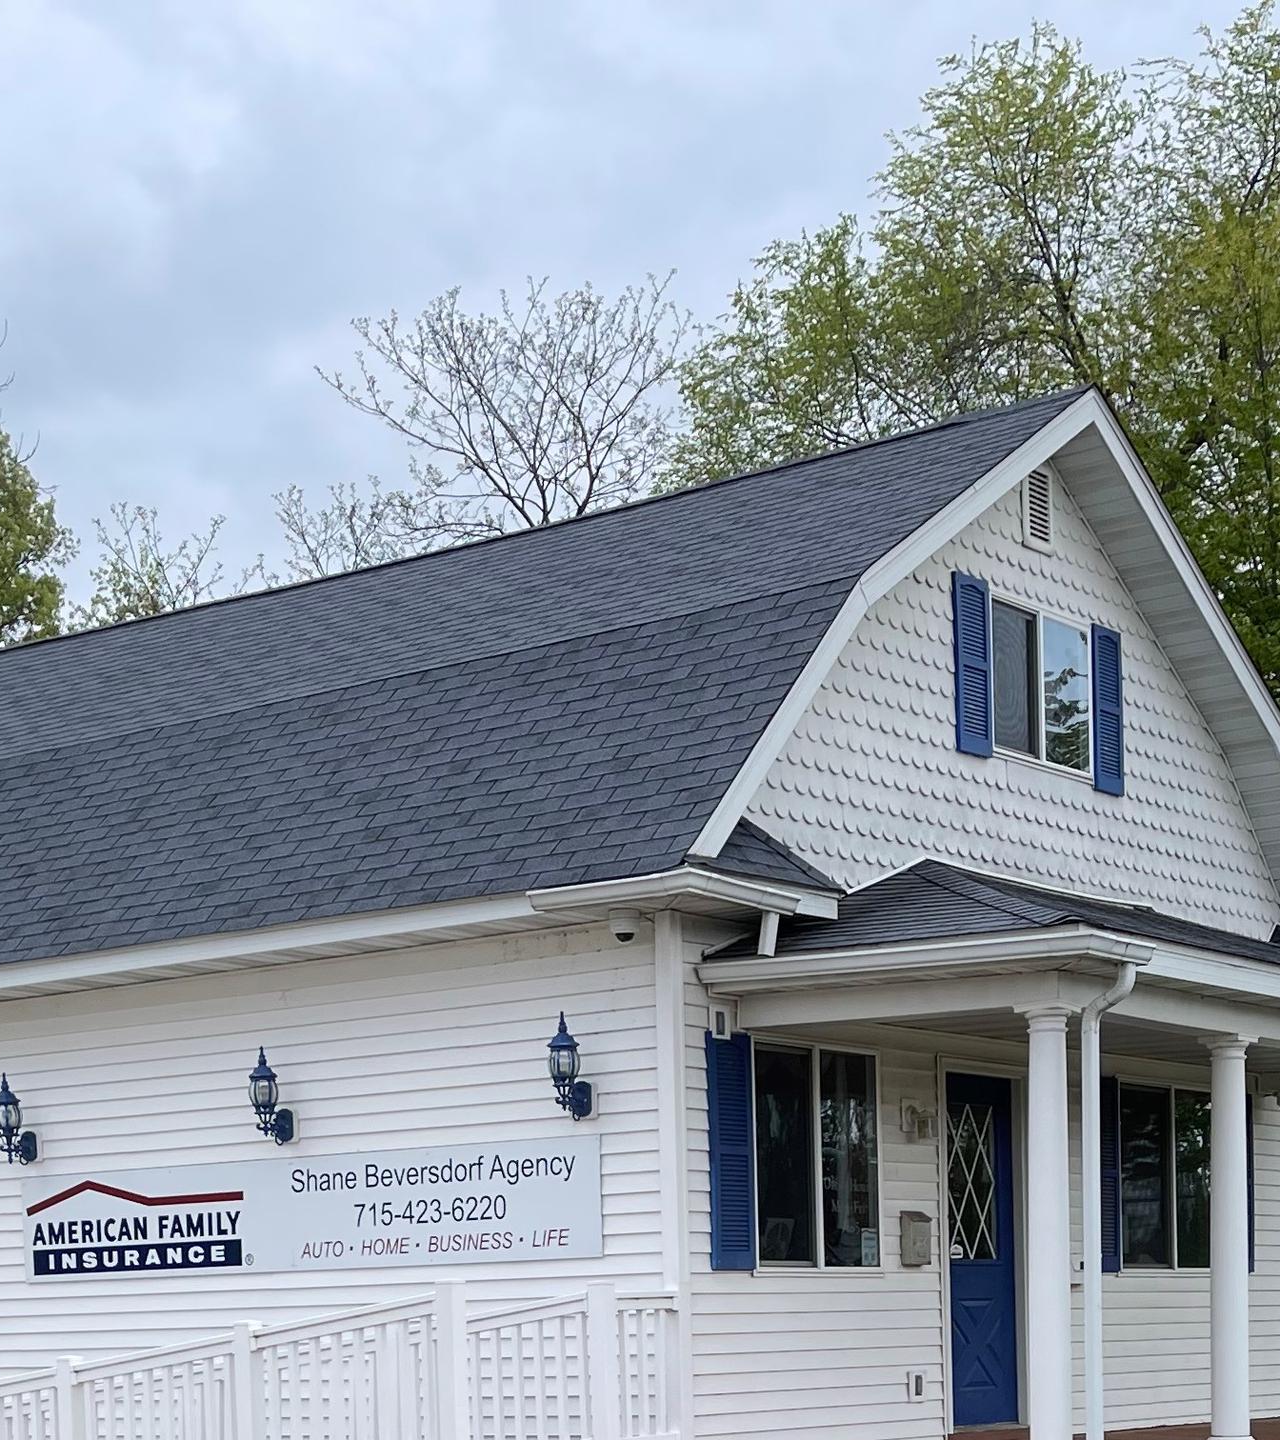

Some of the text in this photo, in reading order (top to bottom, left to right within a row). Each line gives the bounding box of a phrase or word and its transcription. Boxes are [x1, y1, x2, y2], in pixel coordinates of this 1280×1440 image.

[291, 1154, 576, 1193] Shane Beversdorf Agency
[353, 1194, 507, 1227] 715-423-6220
[32, 1211, 241, 1246] AMERICAN FAMILY
[301, 1228, 570, 1259] AUTO HOME BUSINESS LIFE
[48, 1244, 226, 1270] INSURANCE
